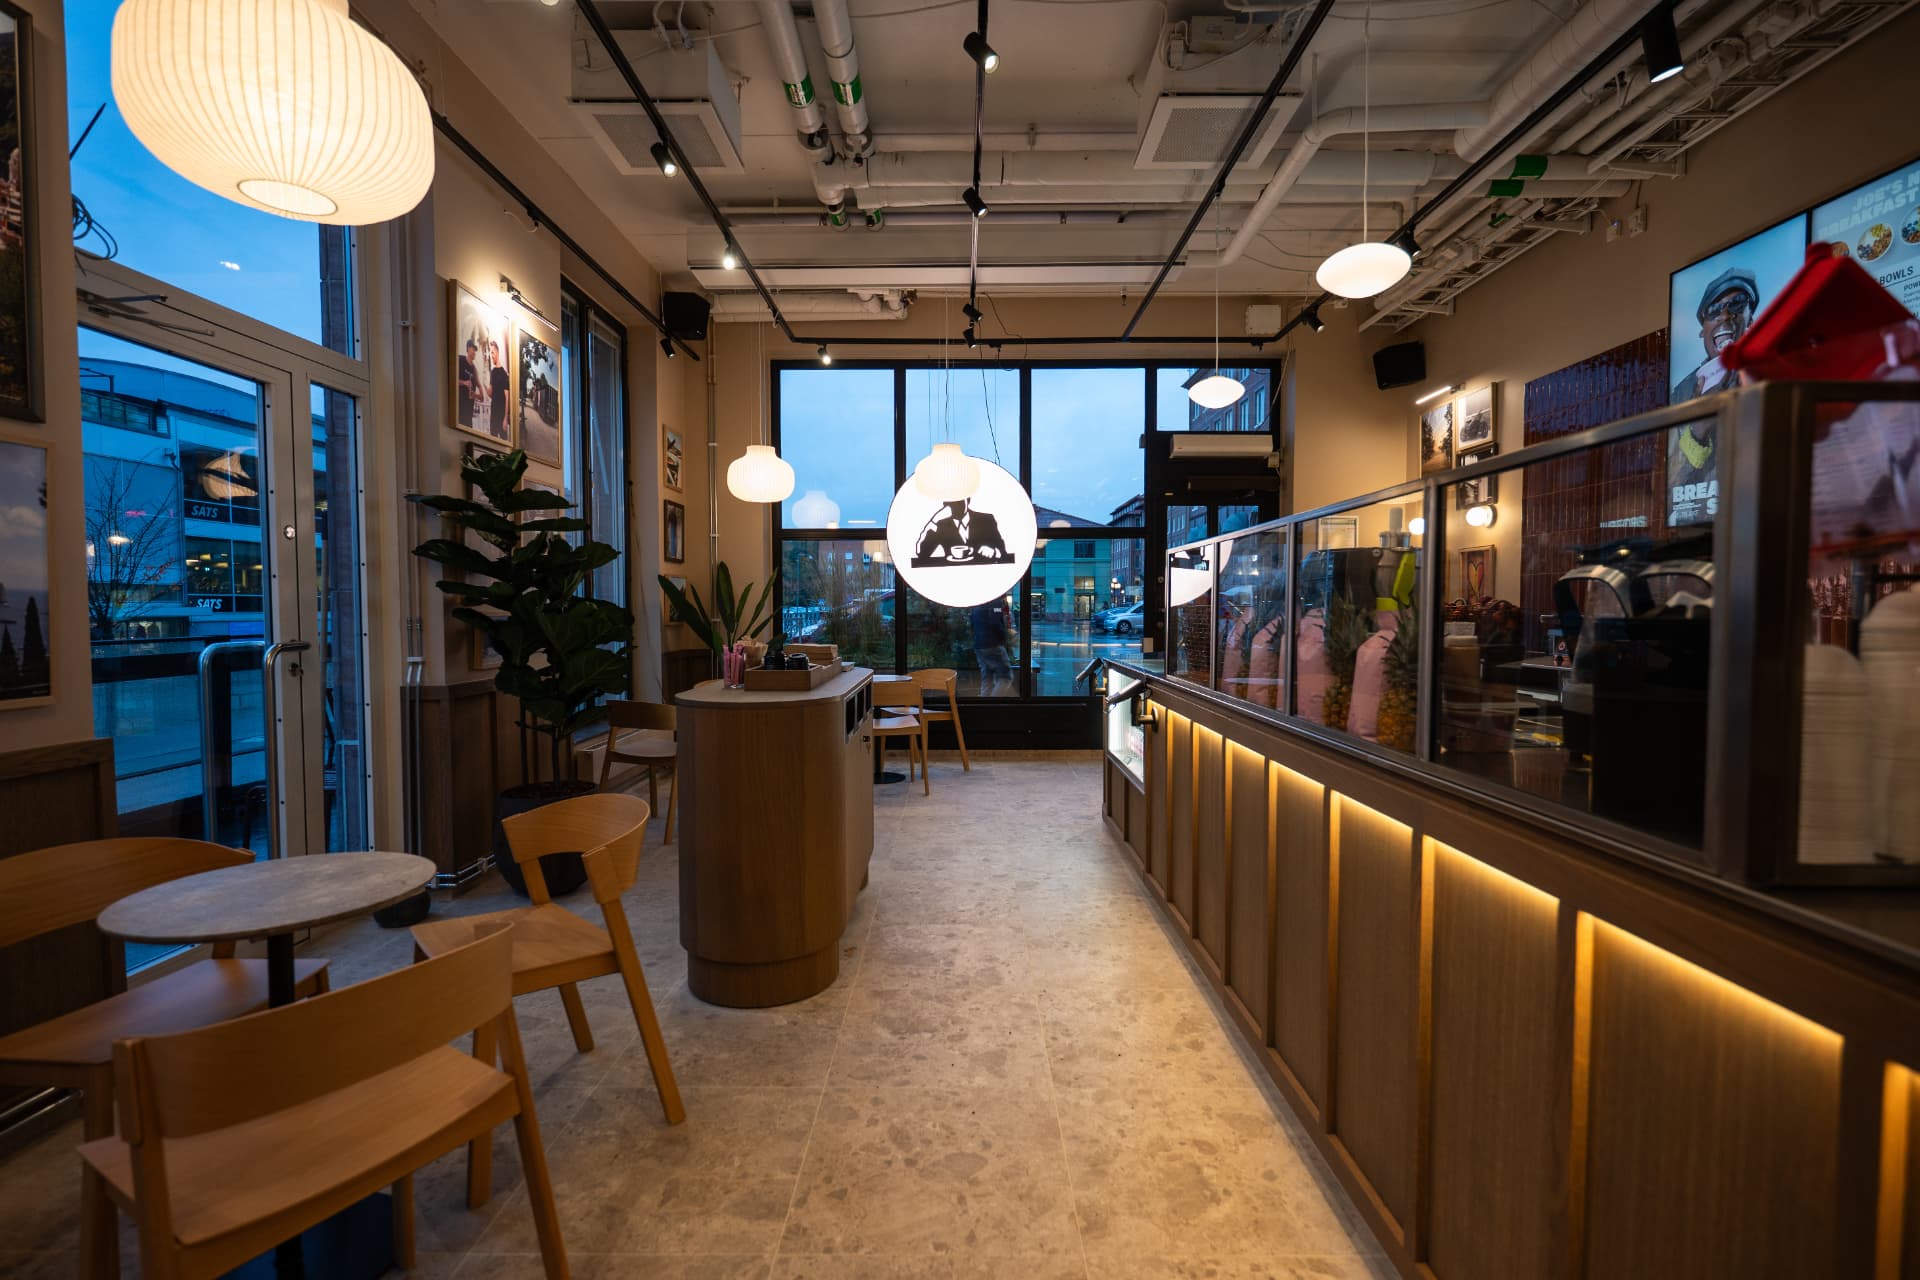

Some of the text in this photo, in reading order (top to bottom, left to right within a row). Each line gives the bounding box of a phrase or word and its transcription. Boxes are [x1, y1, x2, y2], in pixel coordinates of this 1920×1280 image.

[1852, 180, 1902, 212] JOE'S
[1818, 187, 1919, 240] BREAKFAST
[1879, 265, 1914, 285] BOWLS
[192, 505, 218, 518] SATS
[196, 599, 222, 609] SATS
